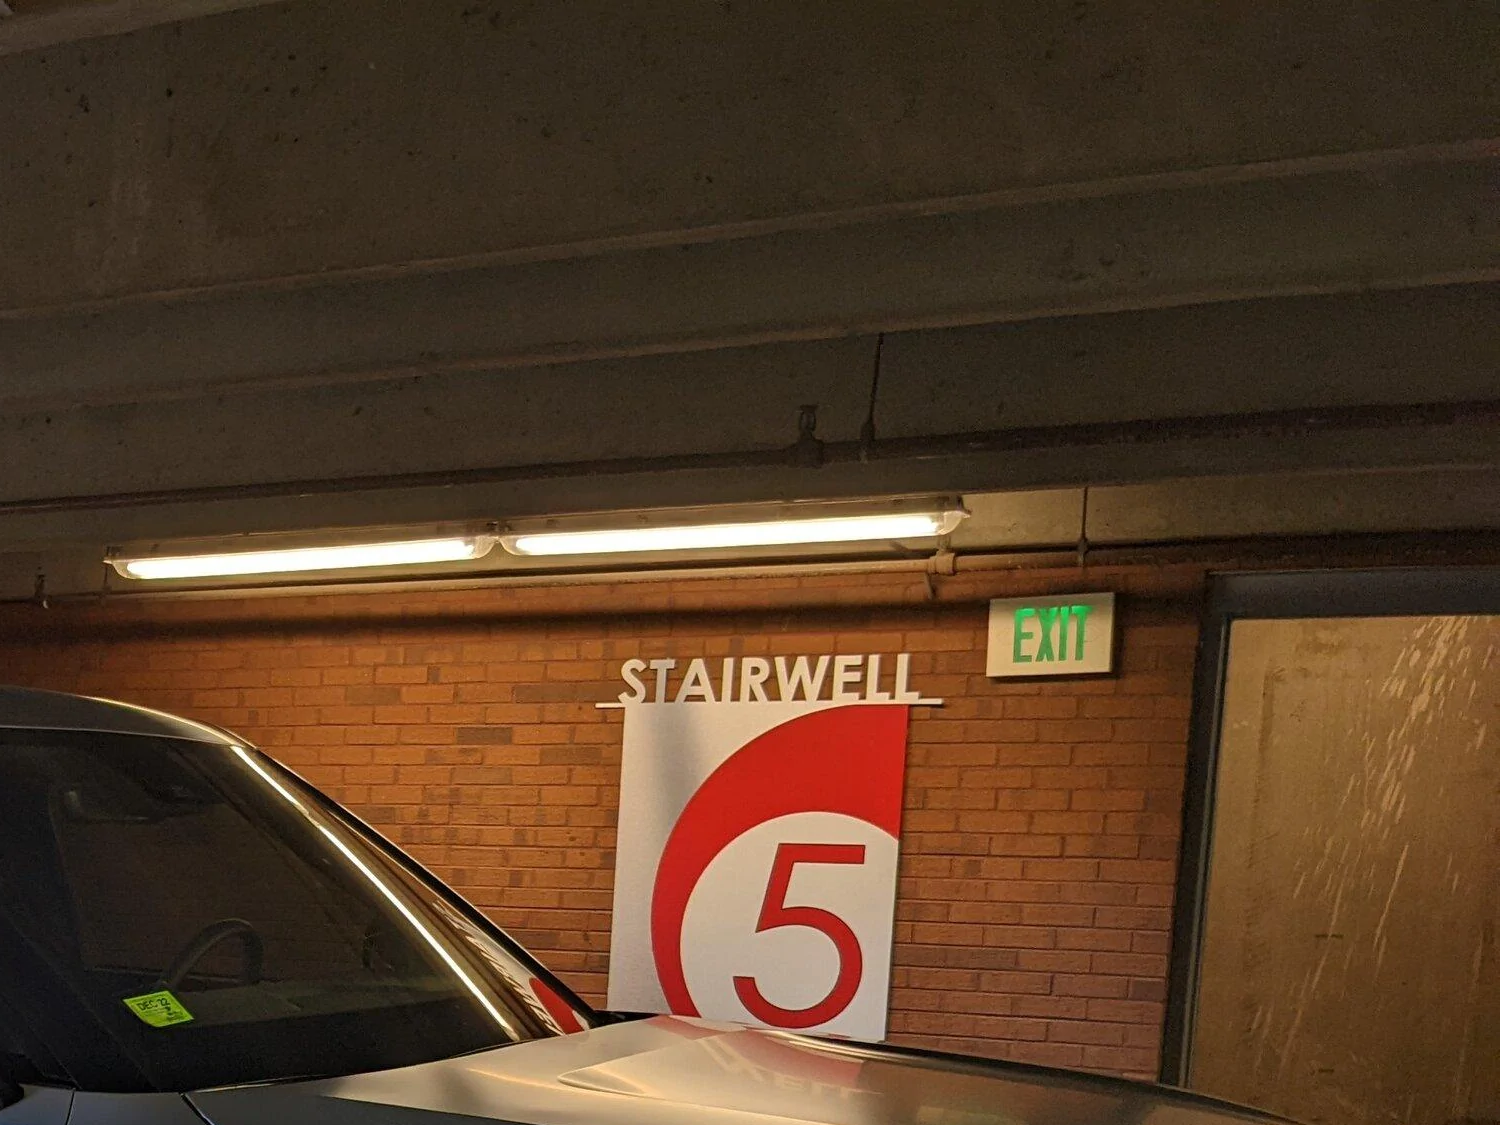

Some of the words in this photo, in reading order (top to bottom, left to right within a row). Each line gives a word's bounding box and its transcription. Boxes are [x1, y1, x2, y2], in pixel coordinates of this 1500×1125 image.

[1012, 605, 1093, 663] EXIT
[617, 653, 920, 704] STAIRWELL
[733, 843, 865, 1029] 5
